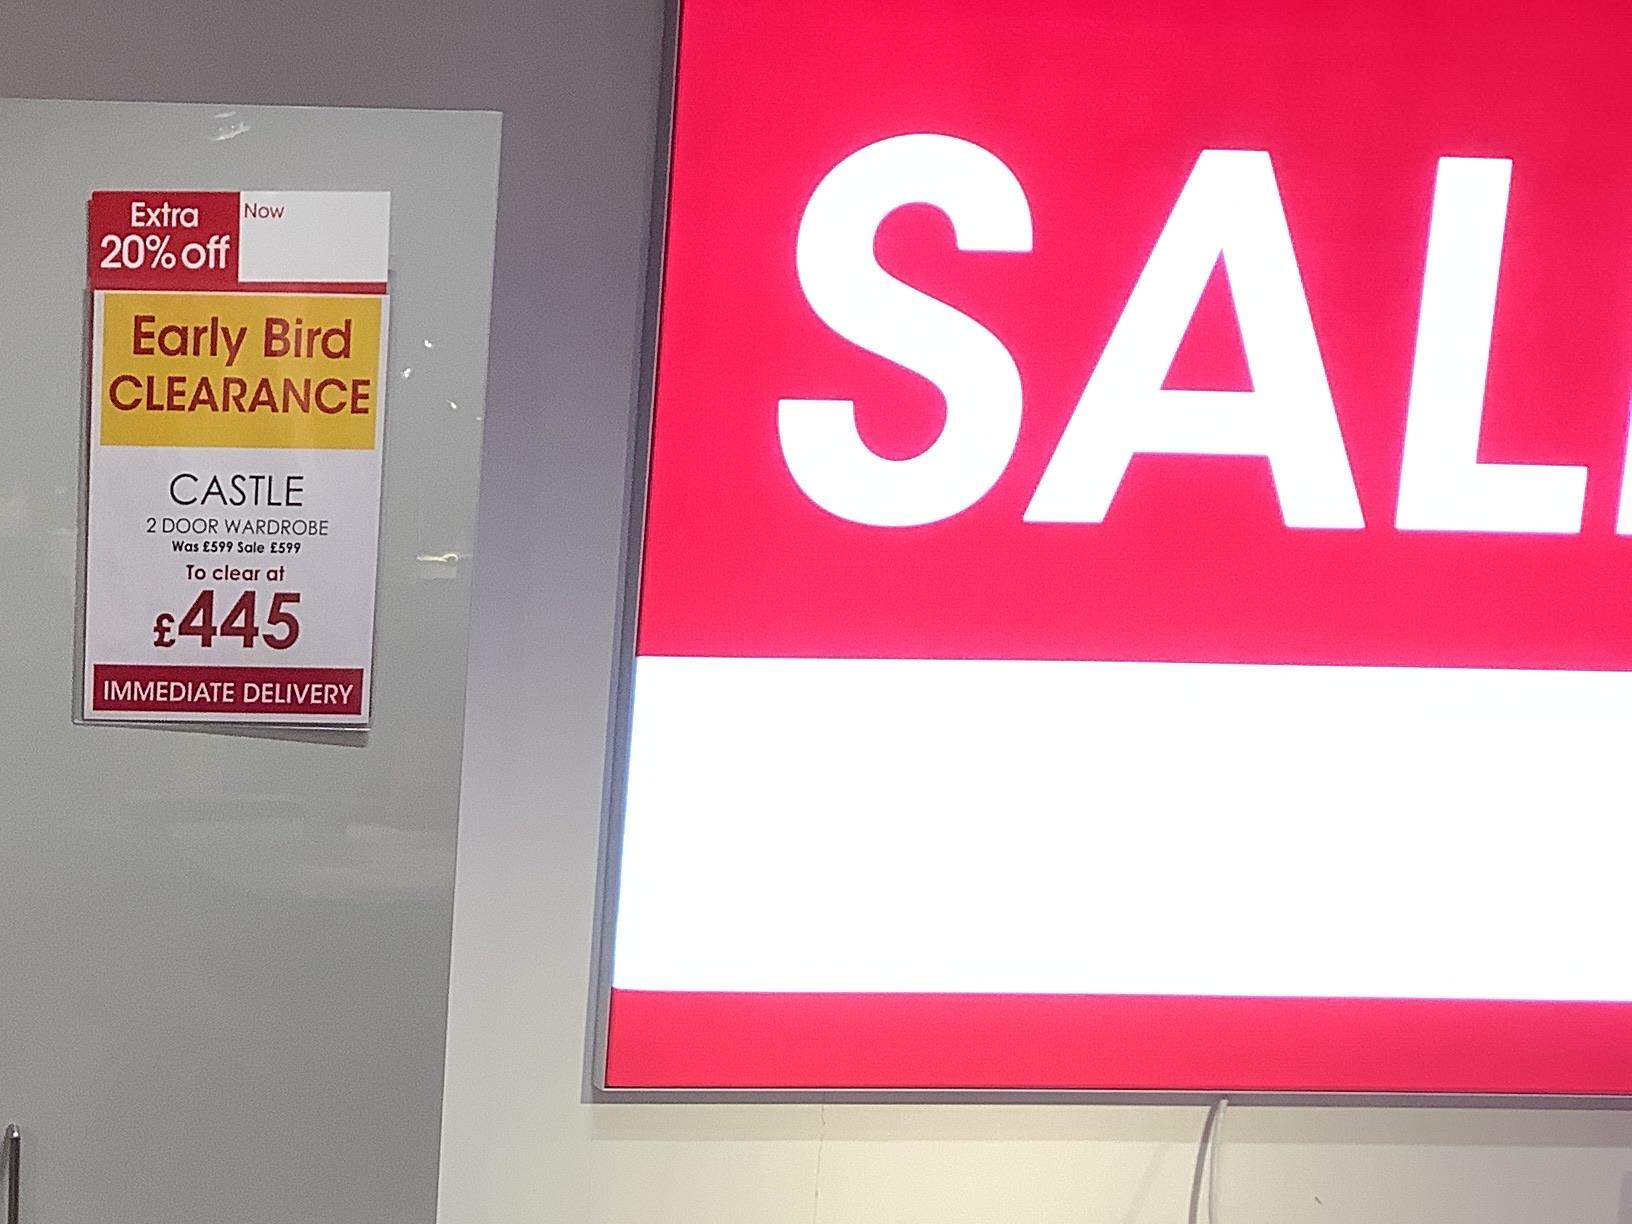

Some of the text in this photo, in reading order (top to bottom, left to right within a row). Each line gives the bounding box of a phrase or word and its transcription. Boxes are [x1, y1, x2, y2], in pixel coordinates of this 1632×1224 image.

[130, 202, 199, 227] Extra
[244, 203, 284, 219] Now
[100, 234, 230, 269] 20% off
[133, 315, 352, 367] Early Bird
[777, 132, 1632, 536] SAL
[108, 374, 371, 414] CLEARANCE
[170, 473, 304, 507] CASTLE
[146, 518, 328, 536] 2 DOOR WARDROBE
[172, 540, 301, 554] Was £599 Sale £599
[186, 564, 285, 582] To clear at
[153, 589, 301, 650] £445
[103, 680, 354, 704] IMMEDIATE DELIVERY
